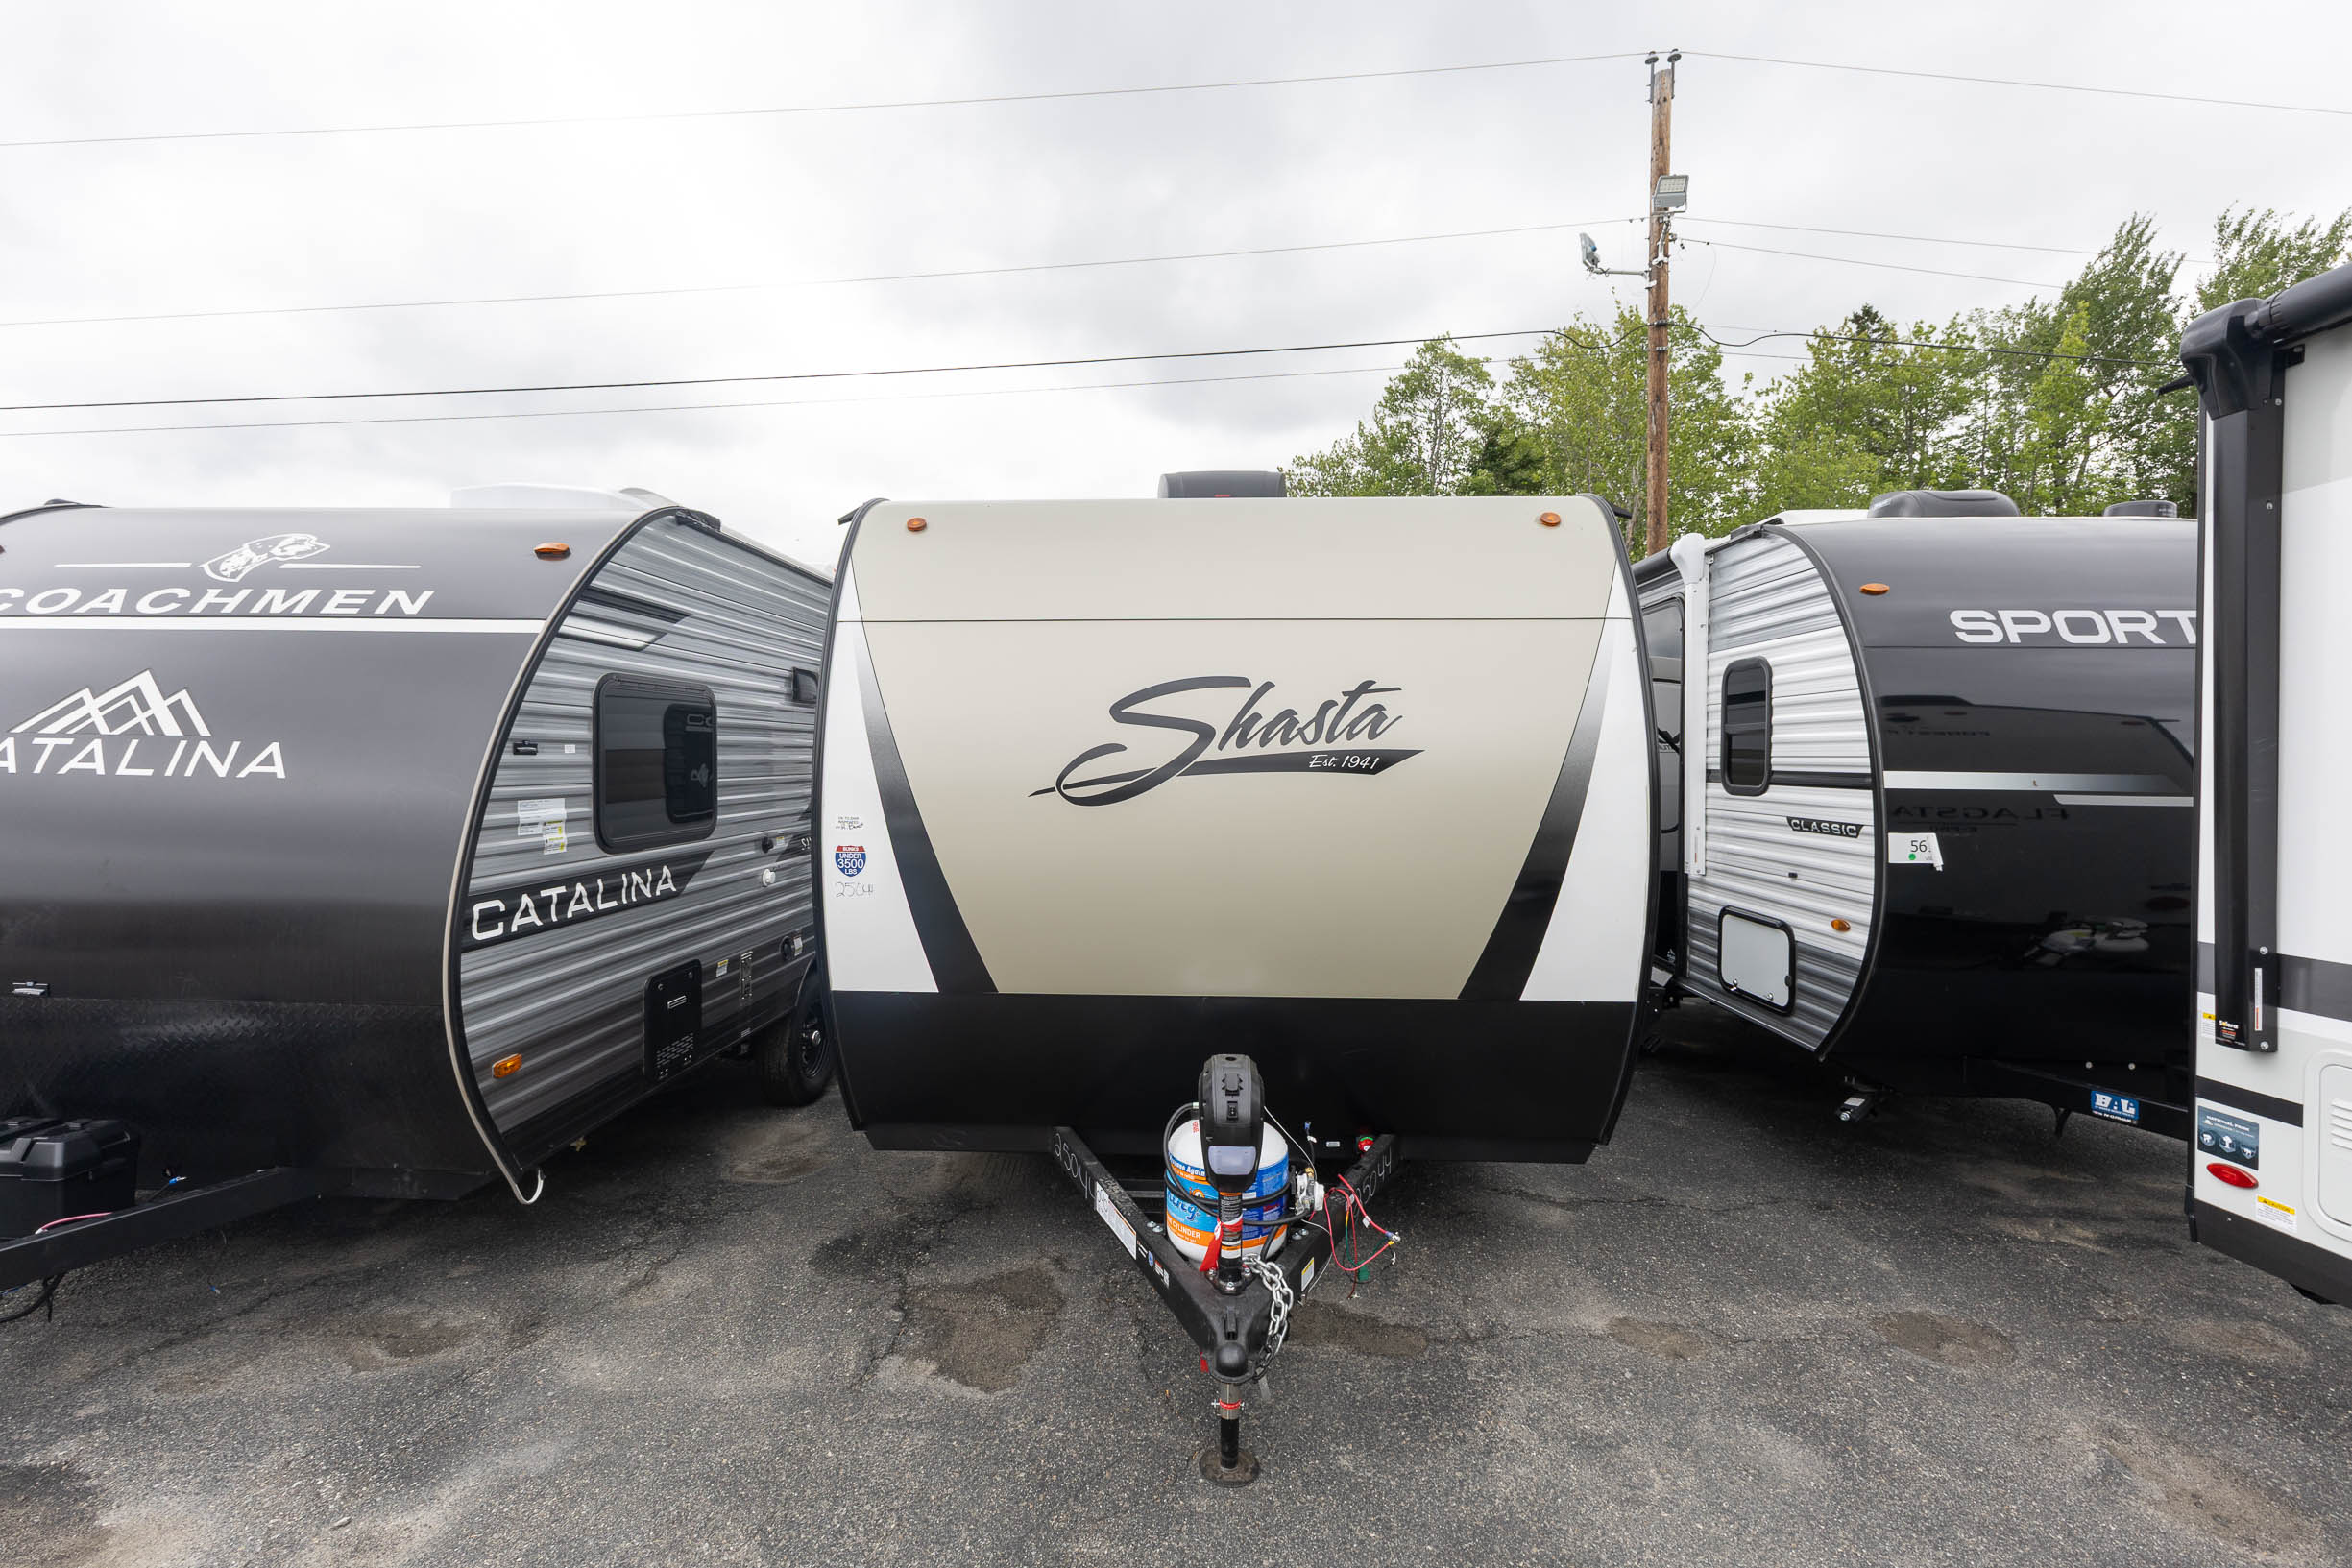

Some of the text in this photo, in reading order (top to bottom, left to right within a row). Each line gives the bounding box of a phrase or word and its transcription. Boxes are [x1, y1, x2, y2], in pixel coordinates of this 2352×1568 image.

[1950, 610, 2197, 644] SPORT
[1055, 675, 1403, 808] Shasta
[1309, 754, 1380, 769] Est. 1941
[1790, 819, 1857, 836] CLASSIC
[1910, 839, 1932, 853] 56
[837, 858, 864, 869] 3500
[471, 864, 678, 942] CATALINA
[1172, 1220, 1200, 1239] CYLINDER
